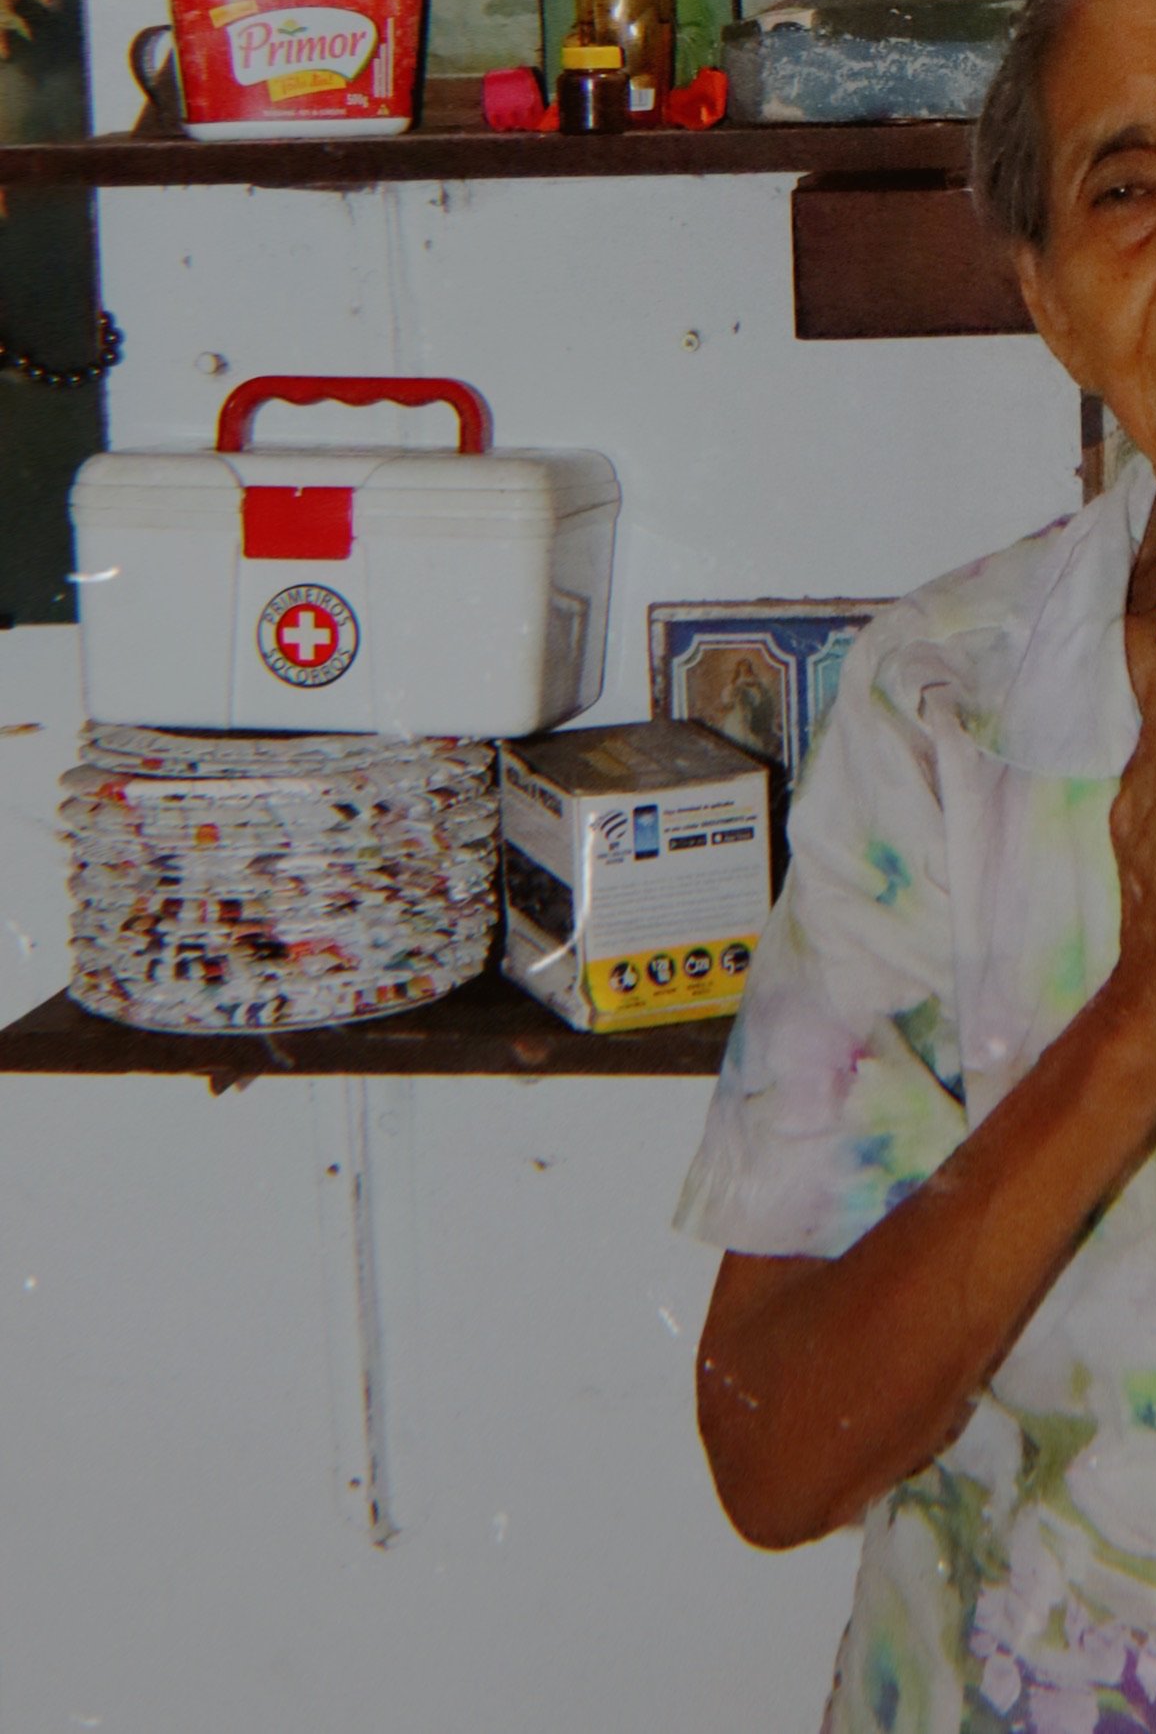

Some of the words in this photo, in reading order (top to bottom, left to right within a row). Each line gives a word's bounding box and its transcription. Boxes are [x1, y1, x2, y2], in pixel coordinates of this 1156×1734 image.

[237, 21, 367, 69] Primor
[264, 587, 351, 627] PRIMEIROS
[264, 647, 351, 685] SOCORROS
